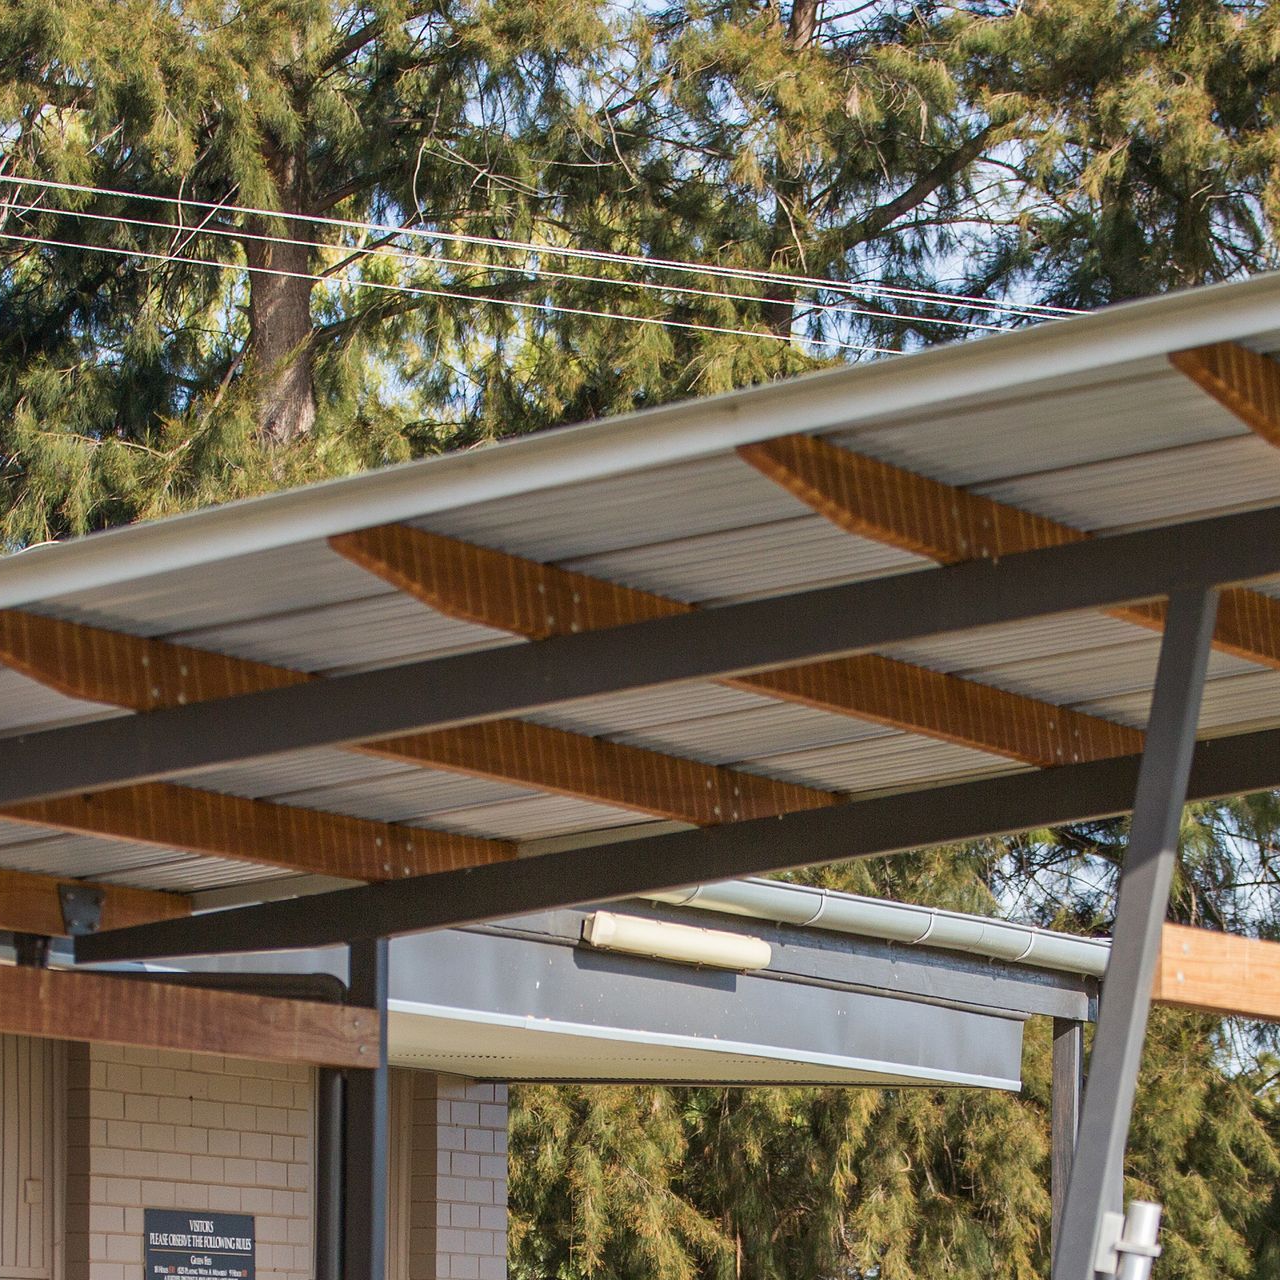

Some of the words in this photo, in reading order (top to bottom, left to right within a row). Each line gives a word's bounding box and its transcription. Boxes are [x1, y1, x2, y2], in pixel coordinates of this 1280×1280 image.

[189, 1220, 214, 1233] VISITORS
[150, 1233, 168, 1246] PLEASE
[169, 1234, 191, 1247] OBSERVE
[192, 1235, 203, 1248] THE
[204, 1236, 235, 1250] FOLLOWING
[236, 1238, 252, 1251] RULES
